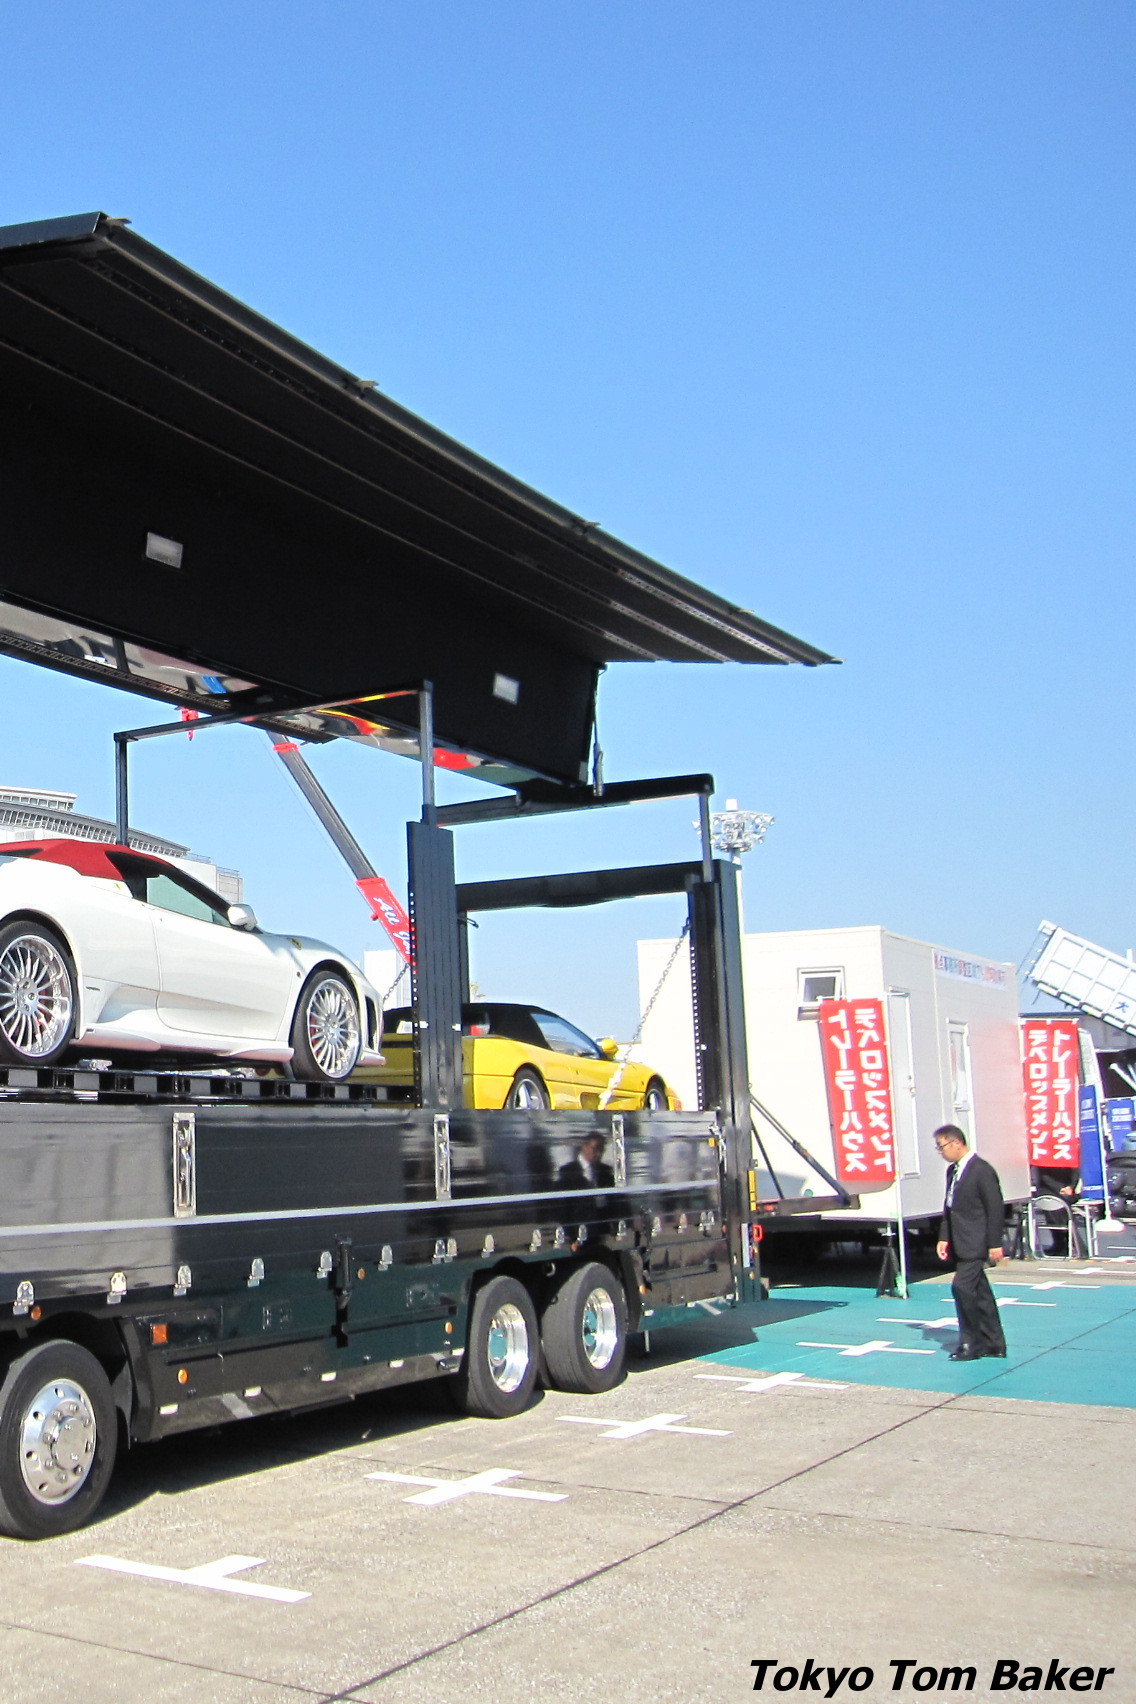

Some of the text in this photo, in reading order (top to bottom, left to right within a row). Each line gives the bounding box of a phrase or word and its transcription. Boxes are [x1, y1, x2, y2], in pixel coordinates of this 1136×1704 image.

[1051, 1029, 1072, 1161] トレーラーハウス
